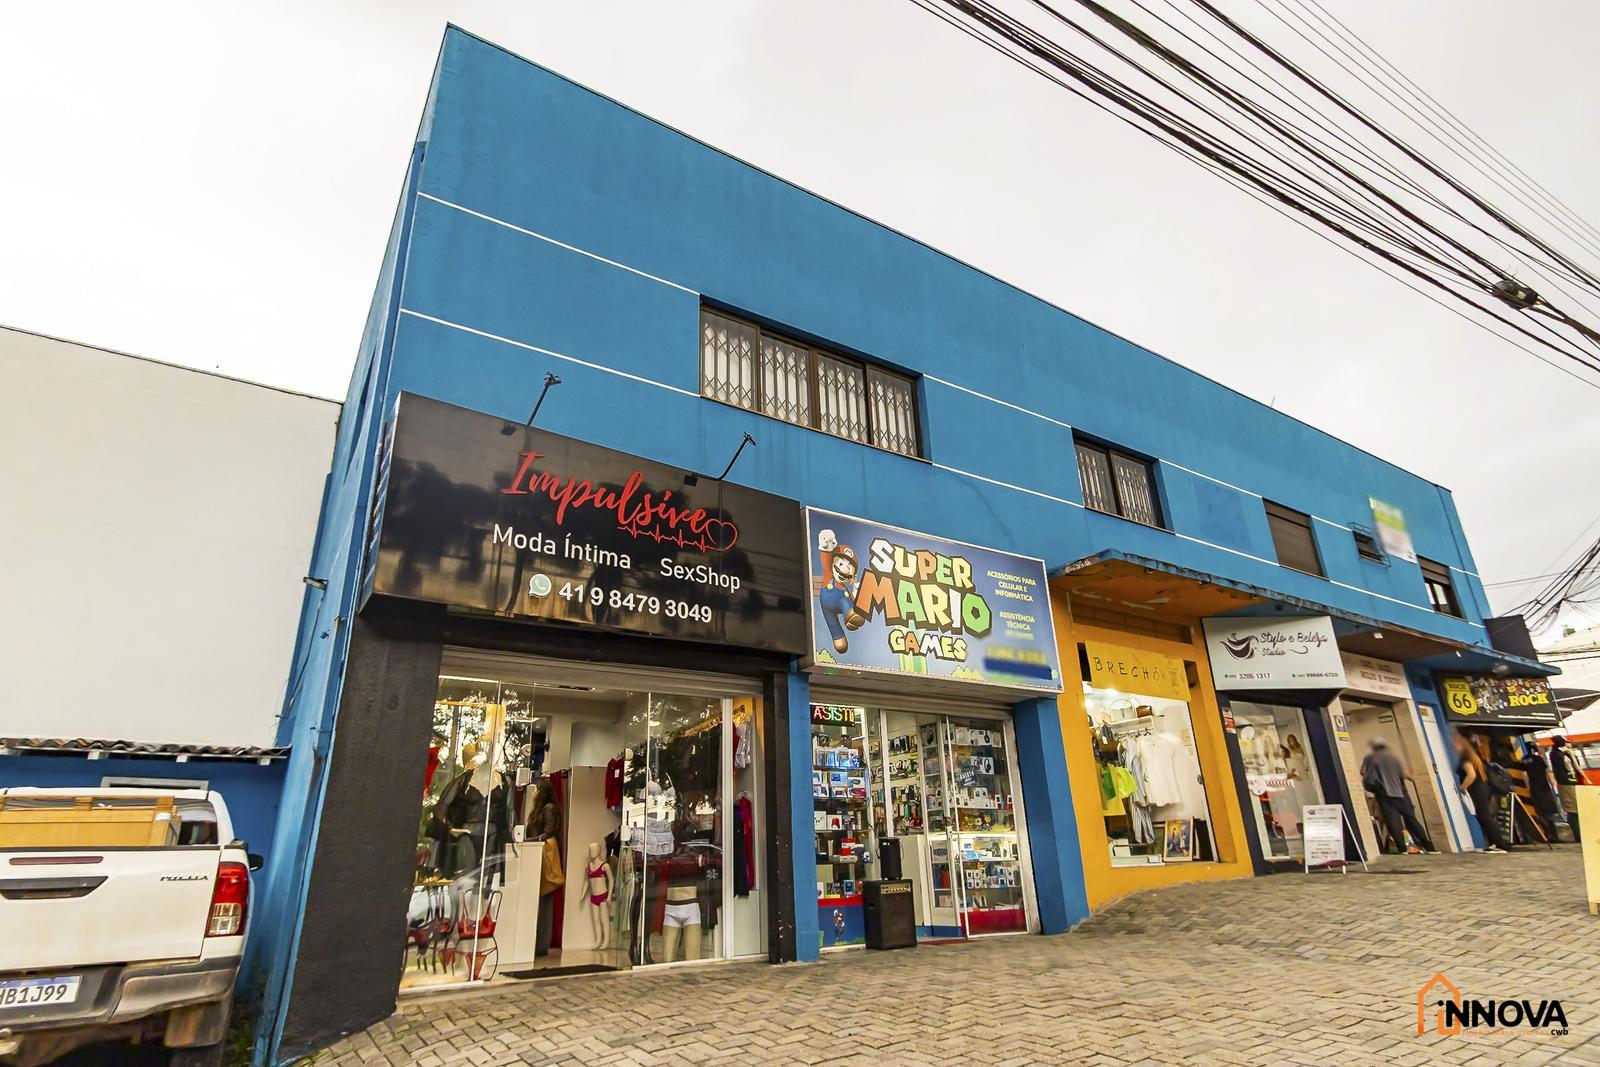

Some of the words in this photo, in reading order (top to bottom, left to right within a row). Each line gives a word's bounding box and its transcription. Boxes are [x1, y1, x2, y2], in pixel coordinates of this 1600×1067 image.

[501, 450, 708, 532] Impulsive
[493, 524, 556, 556] Moda
[564, 532, 631, 569] Íntima
[660, 558, 741, 592] SexShop
[869, 537, 975, 589] SUPER
[998, 581, 1023, 592] CELULAR
[1021, 577, 1037, 586] PARA
[609, 590, 660, 615] 8479
[665, 600, 712, 623] 3049
[853, 568, 992, 637] MARIO
[888, 628, 967, 662] GAMES
[1453, 693, 1471, 709] 66
[1509, 692, 1550, 707] ROCK
